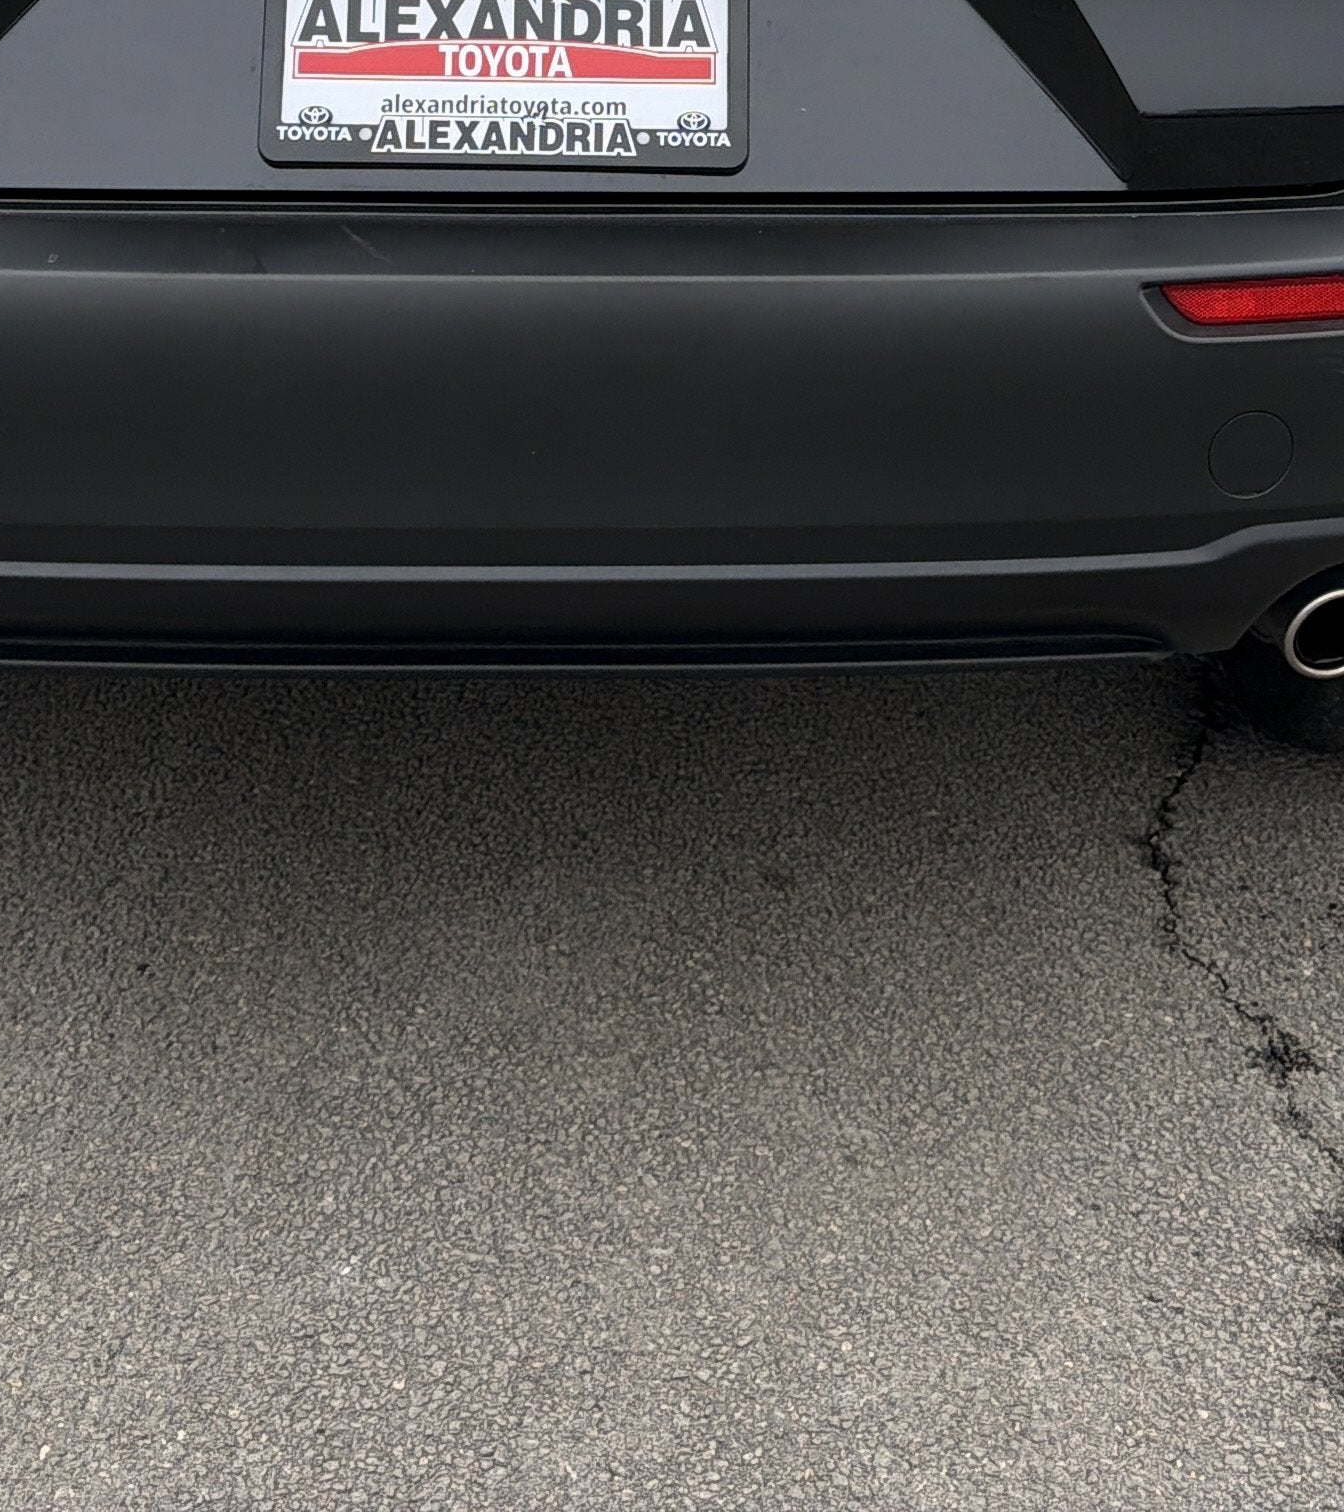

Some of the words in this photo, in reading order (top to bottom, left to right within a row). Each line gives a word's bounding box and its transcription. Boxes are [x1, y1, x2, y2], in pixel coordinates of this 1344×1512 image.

[438, 44, 574, 78] TOYOTA
[380, 93, 628, 119] alexandriatoyota.com
[276, 125, 353, 142] TOYOTA
[373, 117, 635, 155] ALEXANDRIA
[656, 131, 732, 148] TOYOTA
